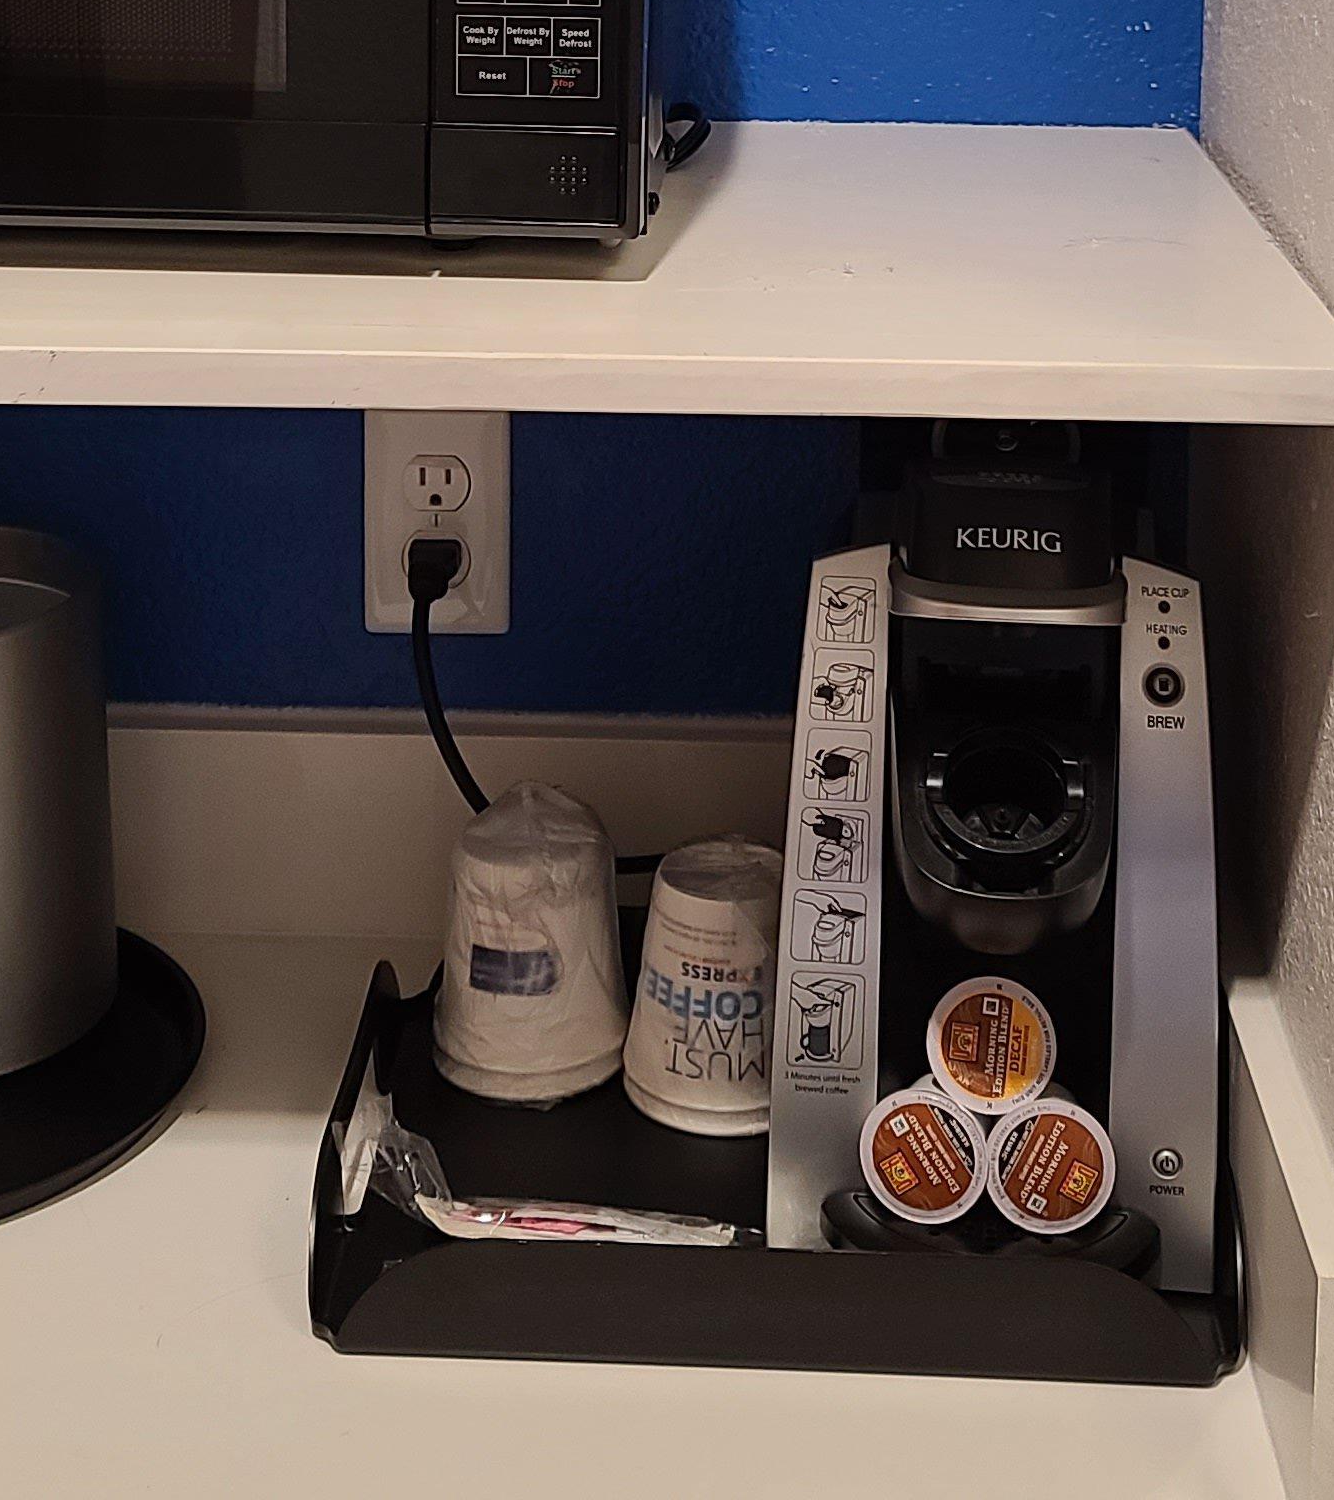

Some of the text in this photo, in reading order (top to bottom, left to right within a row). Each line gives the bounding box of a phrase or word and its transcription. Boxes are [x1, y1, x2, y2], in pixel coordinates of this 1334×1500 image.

[463, 26, 499, 36] Cook By
[466, 36, 496, 45] Weight
[506, 27, 550, 37] Defrost By
[562, 29, 590, 38] Speed
[514, 37, 543, 47] Weight
[559, 39, 592, 48] Defrost
[479, 71, 507, 80] Reset
[956, 528, 1062, 553] KEURIG
[1141, 586, 1189, 598] PLACE CUP
[1146, 623, 1187, 635] HEATING
[1146, 715, 1185, 730] BREW
[645, 967, 764, 1020] COFFEE
[673, 1018, 764, 1050] HAVE
[985, 1020, 998, 1076] MORNING
[1009, 1025, 1023, 1072] DECAF
[665, 1044, 765, 1081] MUST
[993, 1047, 1006, 1094] EDITION
[790, 1071, 821, 1081] Minutes
[795, 1084, 849, 1094] brewed coffee
[909, 1115, 933, 1151] BLEND
[1038, 1120, 1066, 1165] EDITION
[907, 1133, 942, 1186] MORNING
[1038, 1141, 1070, 1193] MORNING
[930, 1150, 961, 1194] EDITION
[1021, 1168, 1043, 1200] BLEND
[1149, 1185, 1186, 1196] POWER
